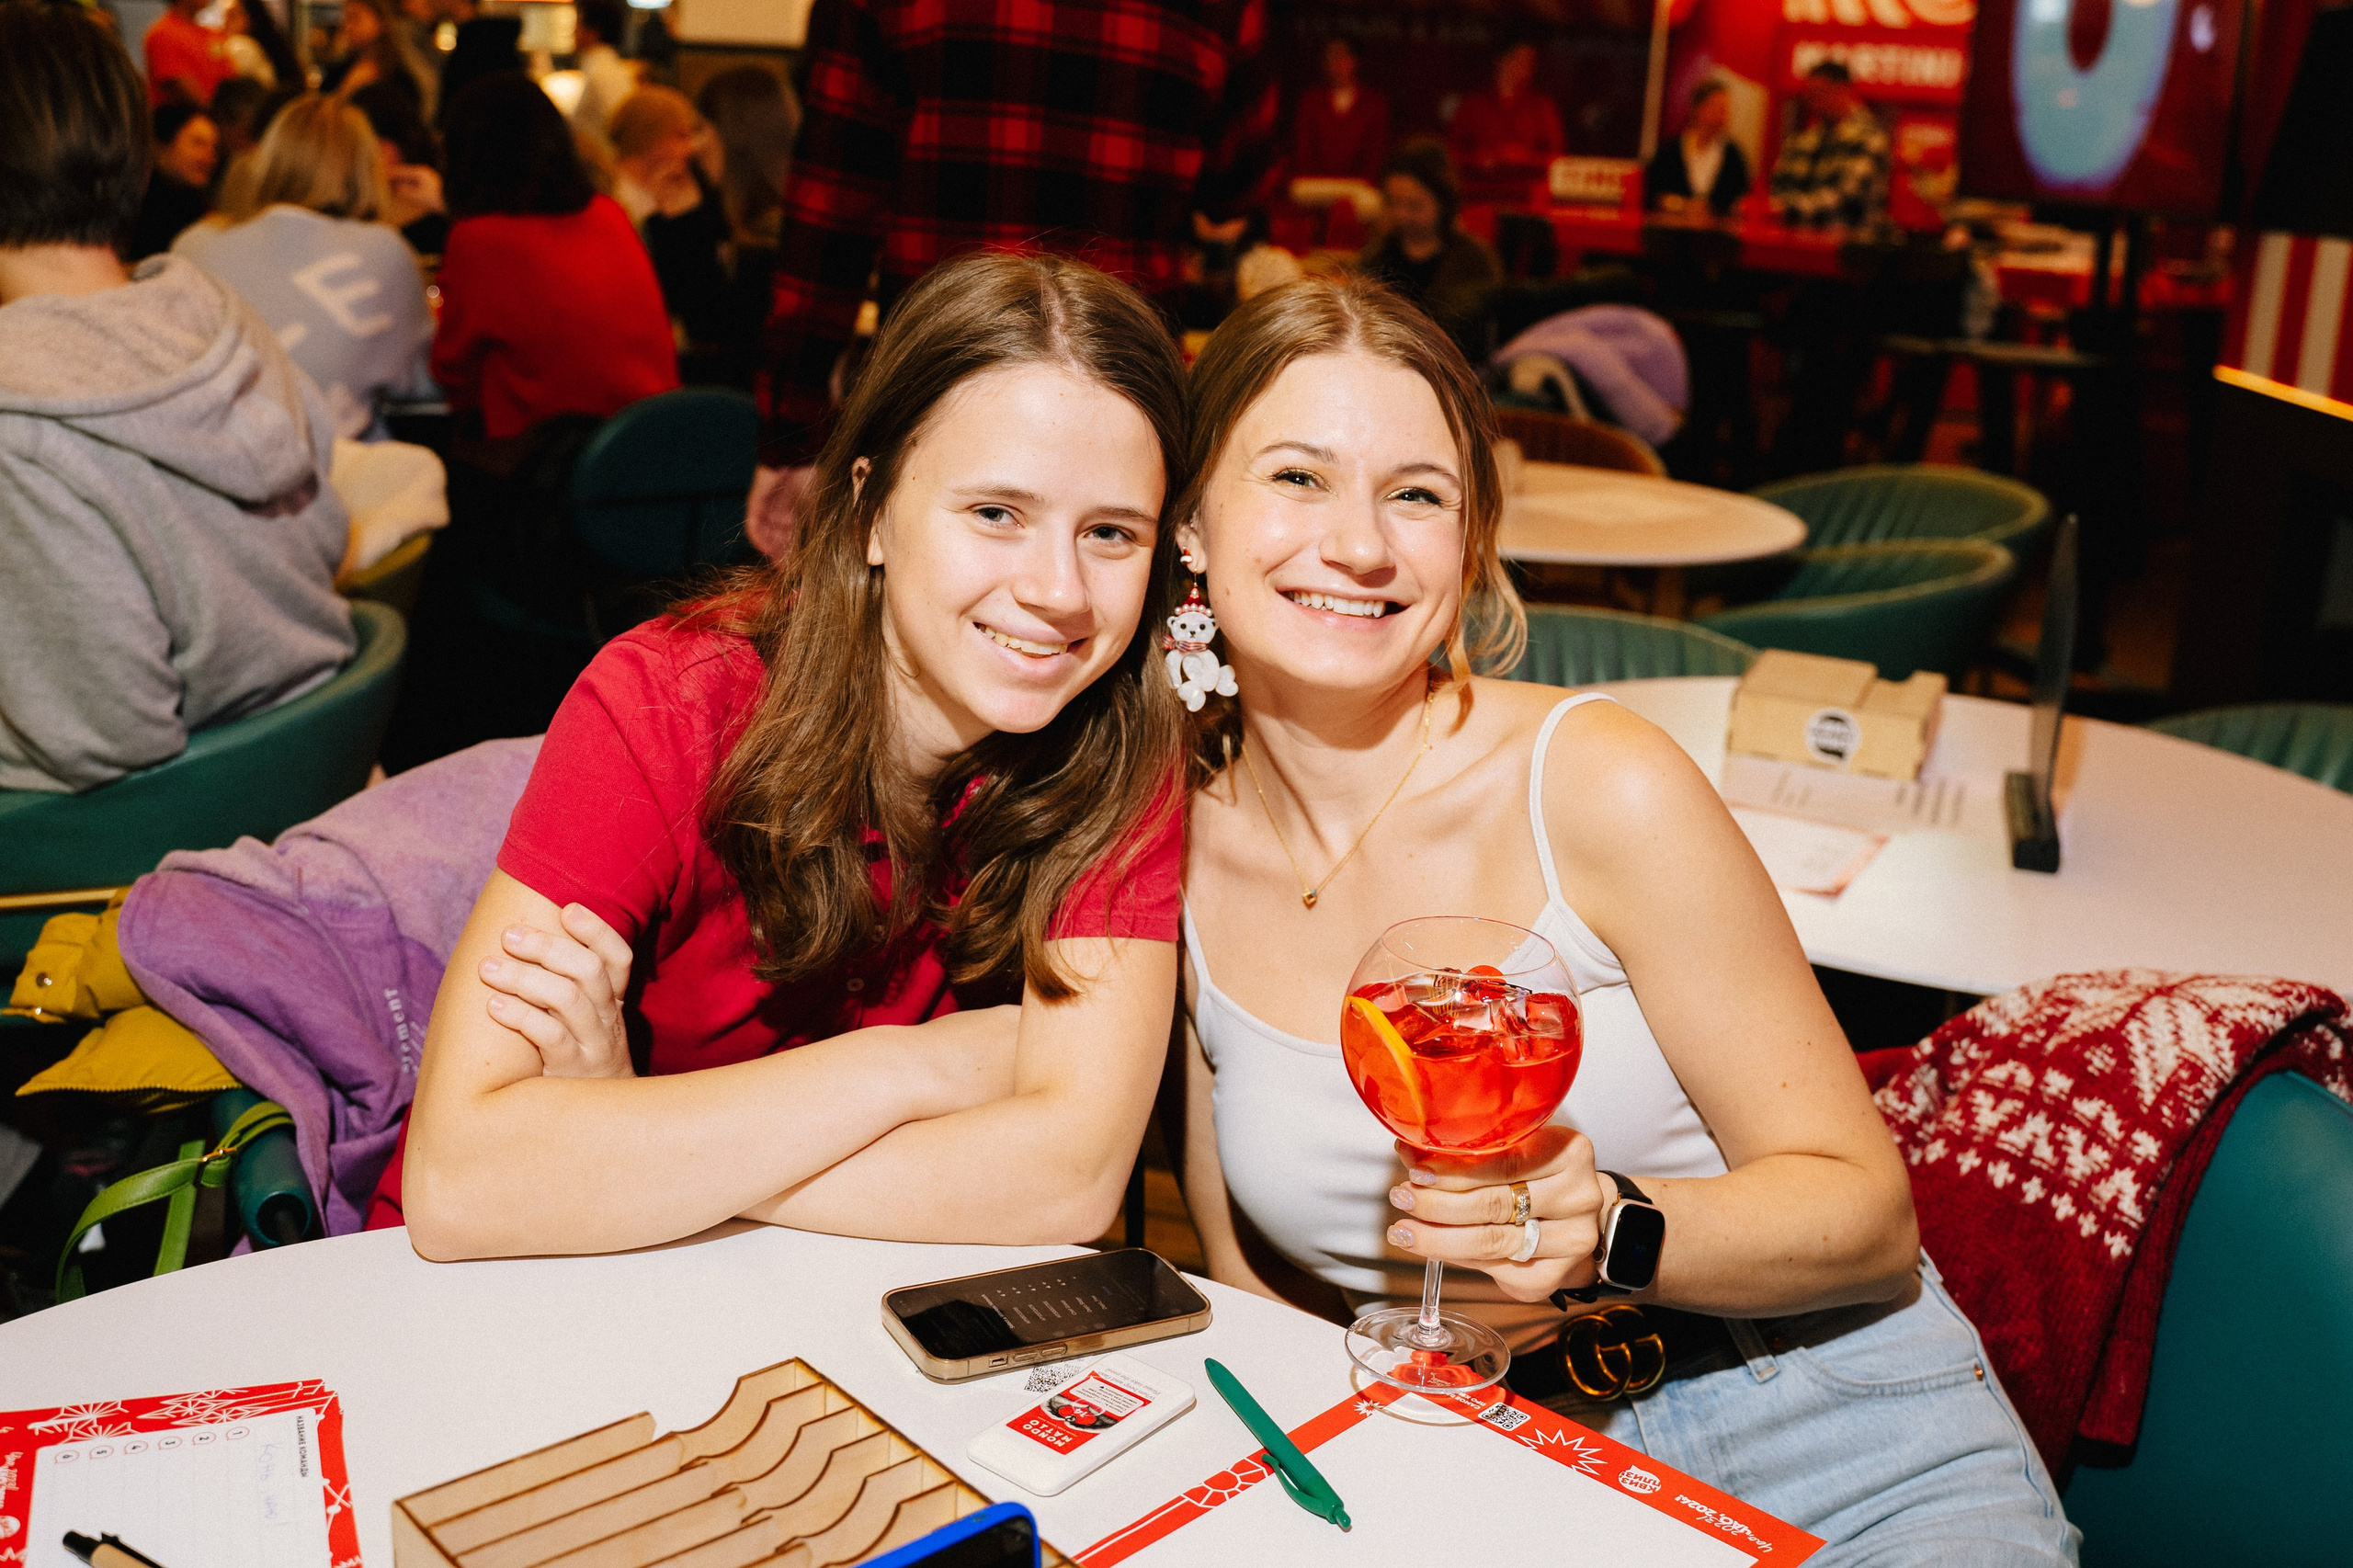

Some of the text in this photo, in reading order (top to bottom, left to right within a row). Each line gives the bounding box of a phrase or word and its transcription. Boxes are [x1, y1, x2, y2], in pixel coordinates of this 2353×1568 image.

[1455, 1395, 1481, 1410] САМОЕ
[296, 1415, 309, 1478] НАЗВАНИЕ КОМАНДЫ
[1022, 1424, 1066, 1448] MONDO
[1674, 1494, 1718, 1517] 2024!
